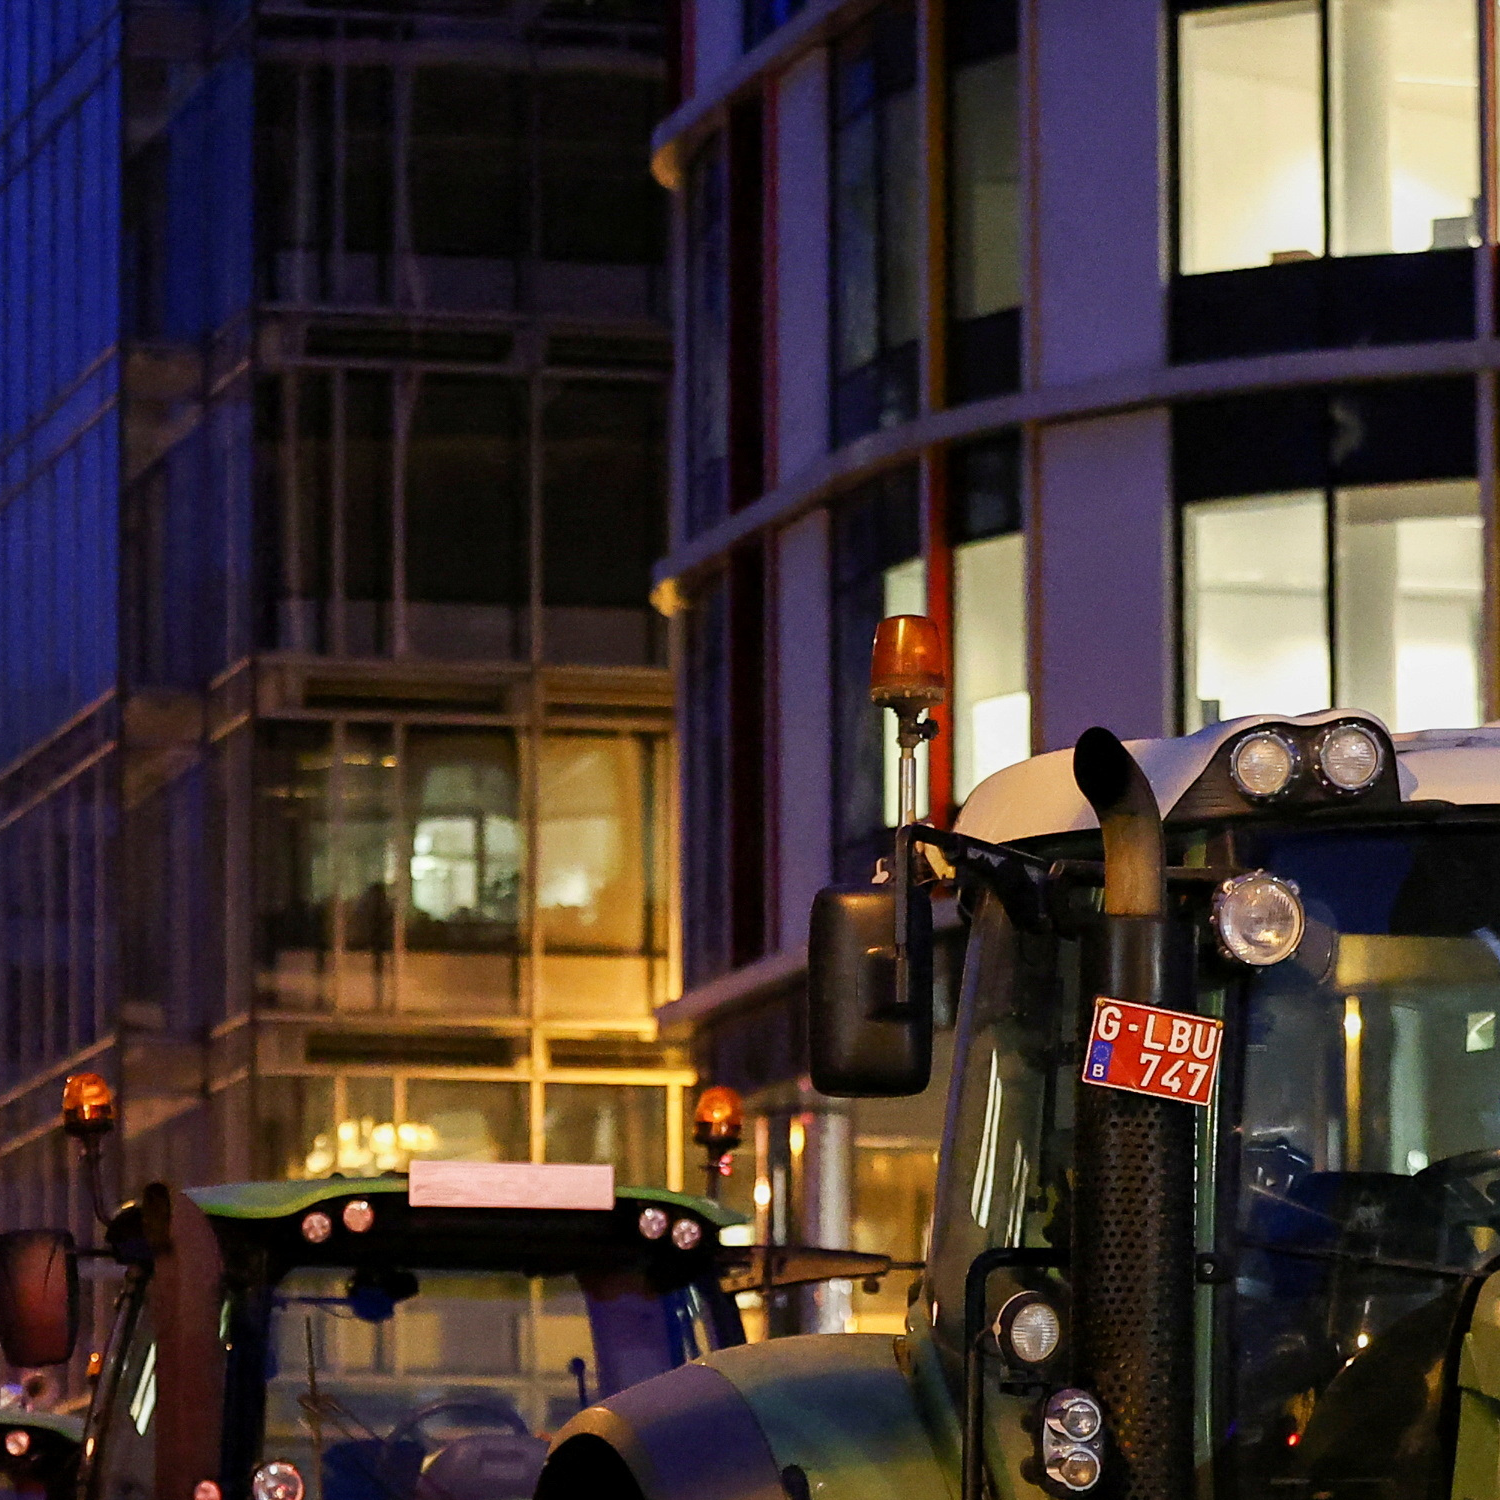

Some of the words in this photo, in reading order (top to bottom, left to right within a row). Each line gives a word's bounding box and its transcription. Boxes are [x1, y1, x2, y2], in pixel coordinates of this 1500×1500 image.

[1097, 1006, 1216, 1060] G-LBU
[1092, 1063, 1105, 1078] B
[1139, 1053, 1210, 1097] 747
